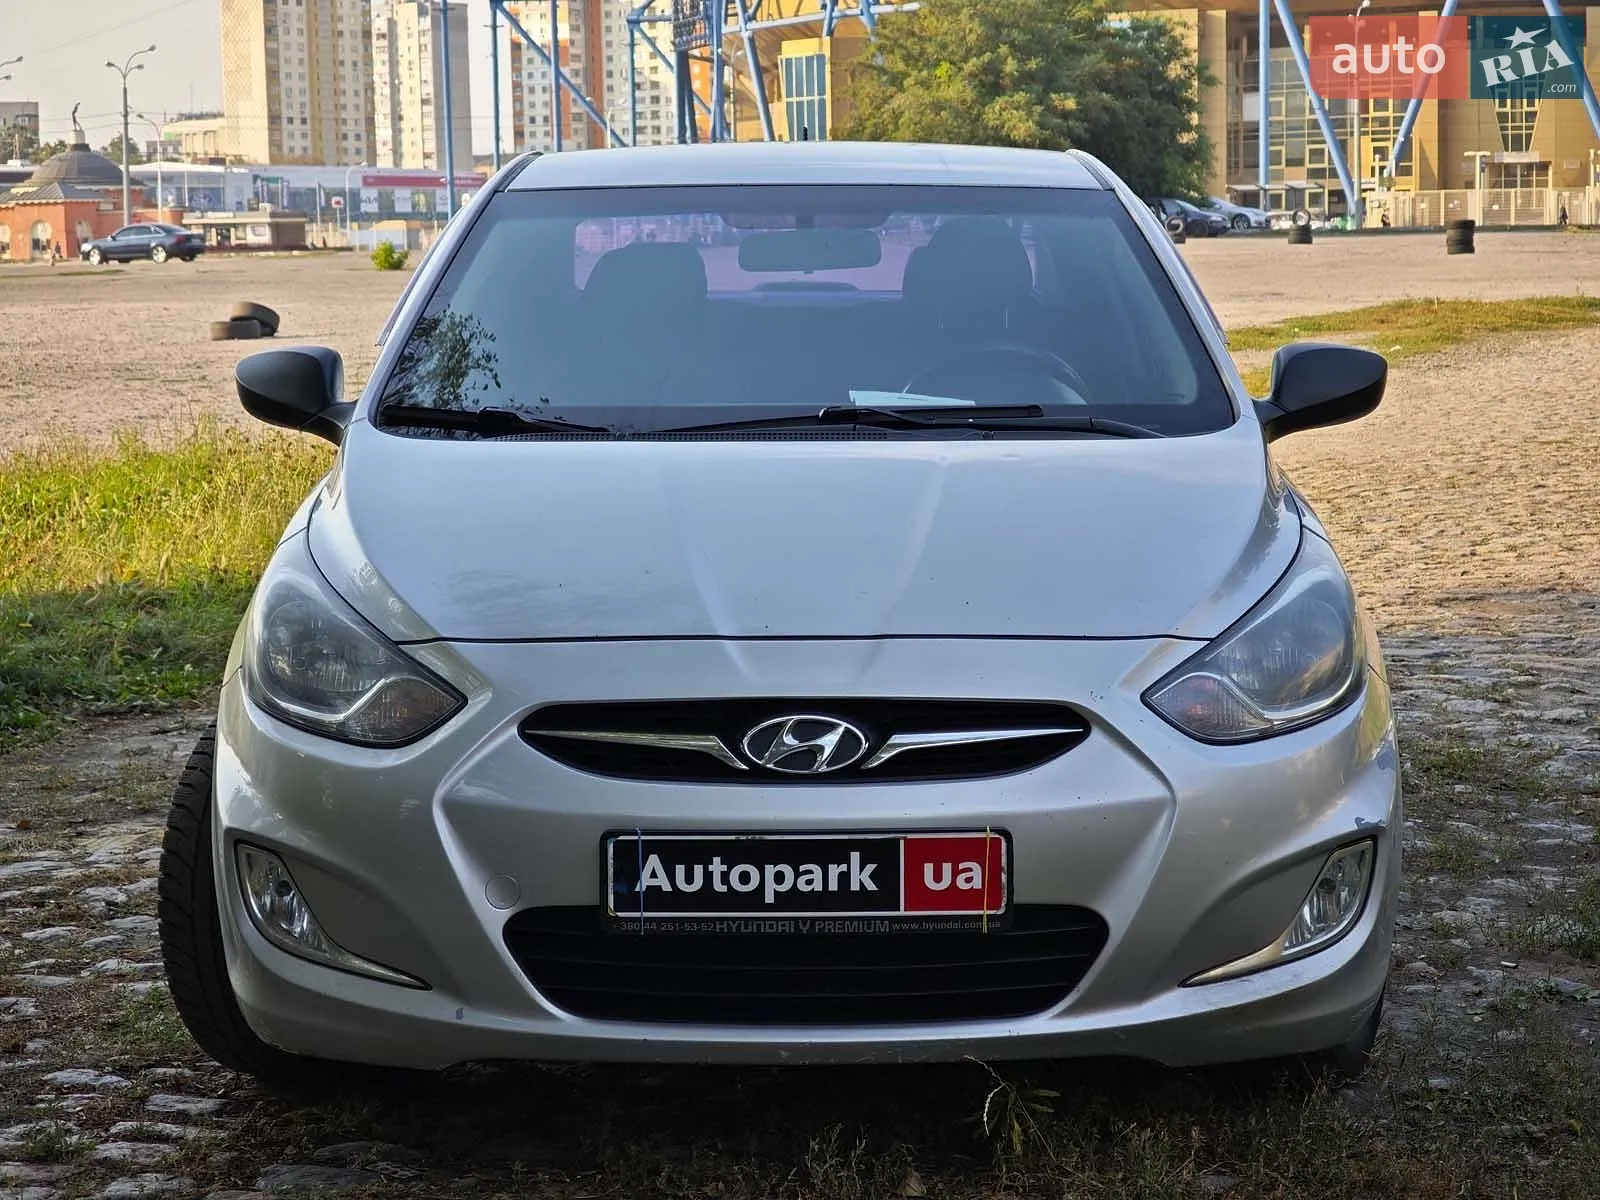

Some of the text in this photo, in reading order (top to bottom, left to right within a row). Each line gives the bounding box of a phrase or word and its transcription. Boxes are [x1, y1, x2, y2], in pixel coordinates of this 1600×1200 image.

[634, 851, 984, 903] Autopark ua
[716, 920, 795, 933] HYUNDAI
[815, 920, 890, 933] PREMIUM
